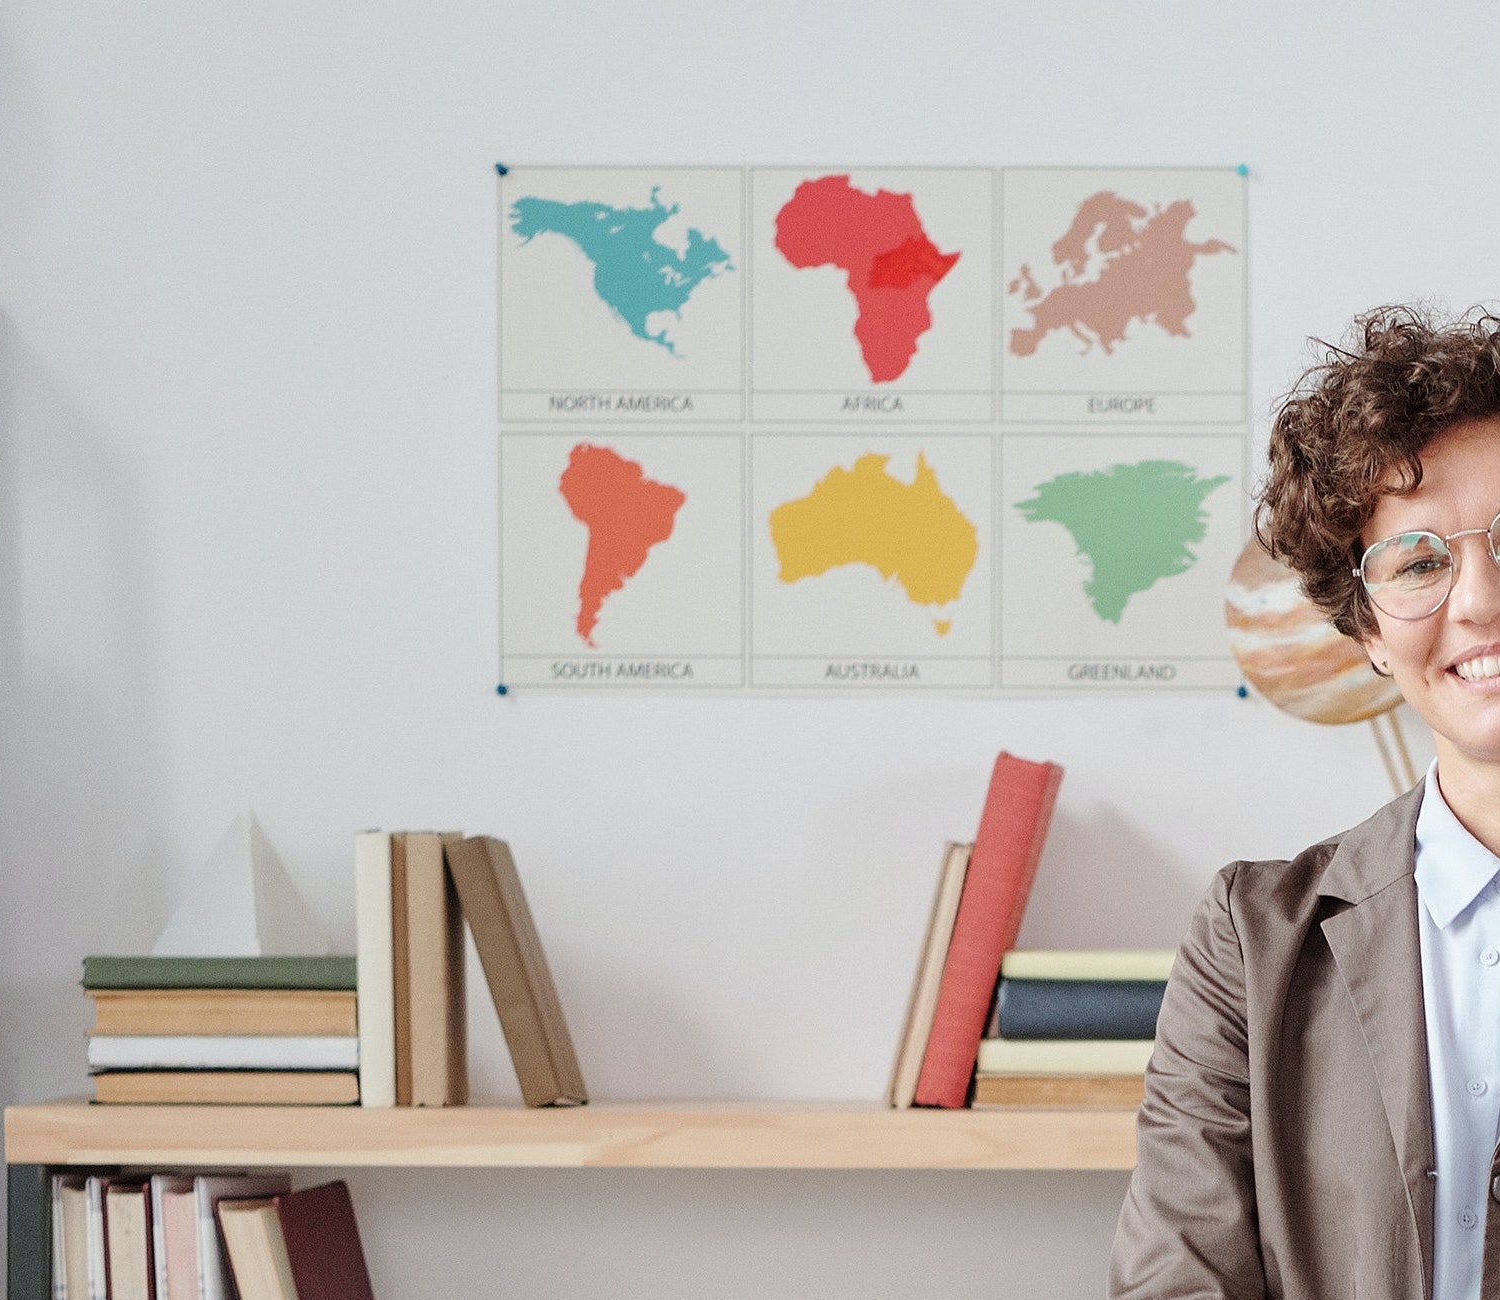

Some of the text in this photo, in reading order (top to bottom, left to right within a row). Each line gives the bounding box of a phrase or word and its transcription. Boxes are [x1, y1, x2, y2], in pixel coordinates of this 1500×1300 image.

[549, 394, 694, 412] NORTH AMERICA
[841, 395, 905, 412] AFRICA
[1086, 396, 1156, 414] EUROPE
[550, 662, 694, 679] SOUTH AMERICA
[825, 663, 920, 680] AUSTRALIA
[1067, 663, 1177, 681] GREENLAND
